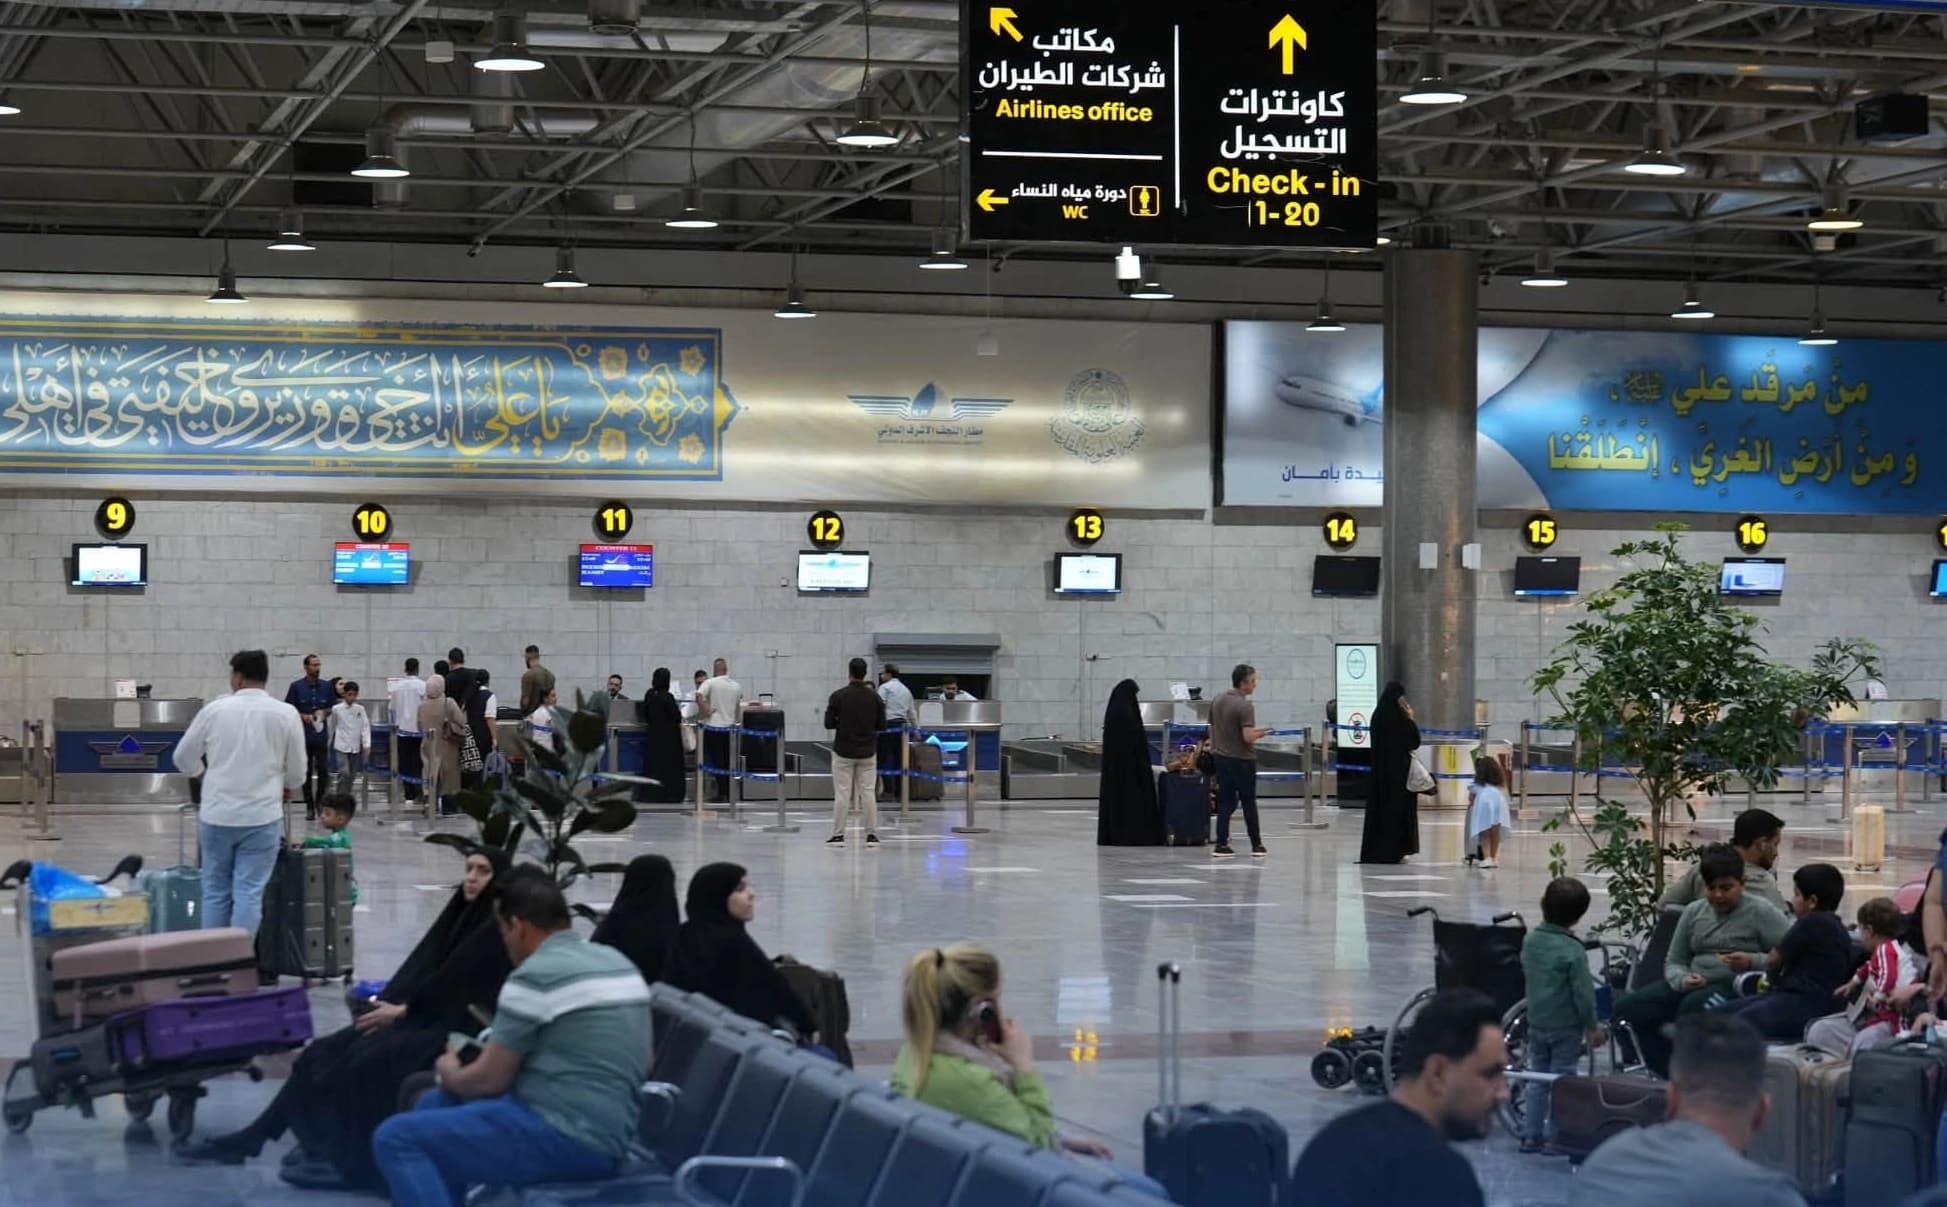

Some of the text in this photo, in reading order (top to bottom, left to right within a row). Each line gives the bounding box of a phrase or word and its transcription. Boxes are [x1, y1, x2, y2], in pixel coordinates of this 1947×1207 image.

[1032, 27, 1115, 57] مكاتب
[978, 60, 1166, 94] شركات الطيران
[995, 99, 1153, 122] Airlines office
[1220, 88, 1346, 124] كاونترات
[1220, 124, 1347, 160] التسجيل
[1011, 182, 1127, 202] دورة مياه النساء
[1062, 205, 1089, 219] WC
[106, 502, 127, 530] 9
[357, 510, 387, 534] 10
[602, 508, 626, 531] 11
[1074, 515, 1102, 539] 13
[812, 517, 840, 541] 12
[1326, 519, 1356, 542] 14
[1528, 519, 1555, 545] 15
[1739, 521, 1766, 545] 16
